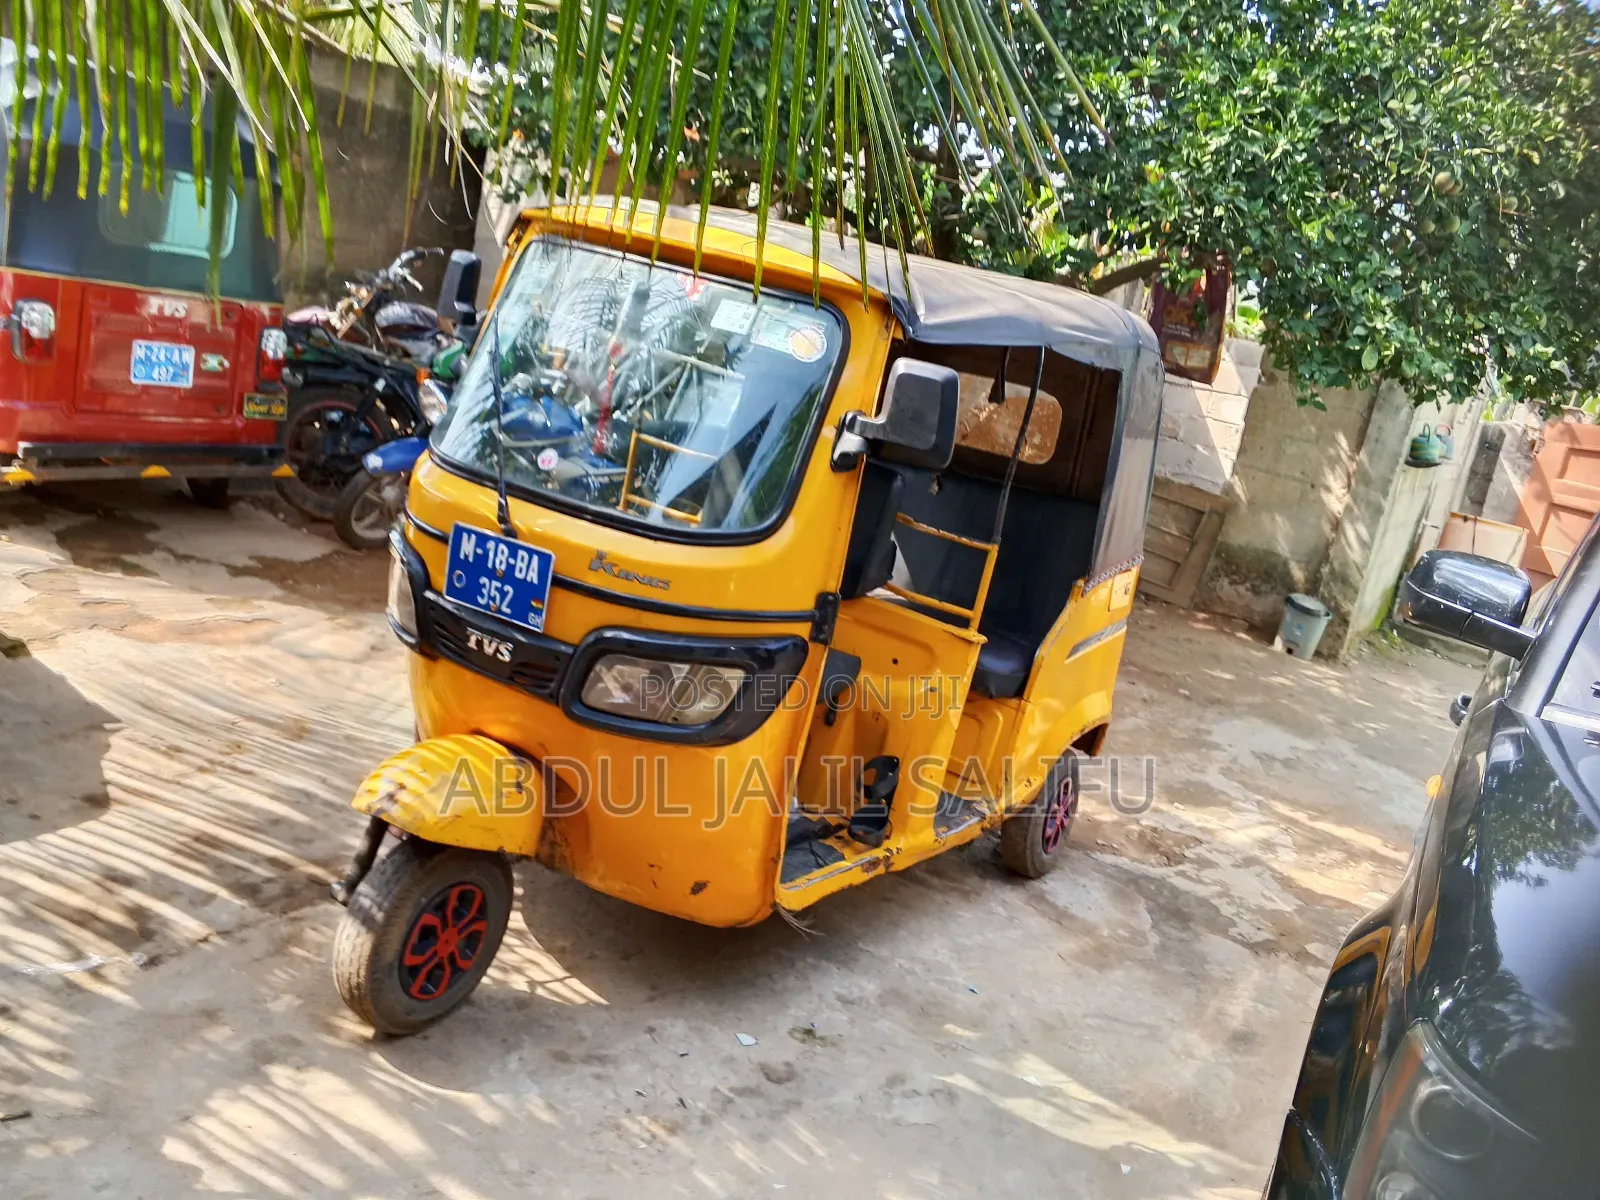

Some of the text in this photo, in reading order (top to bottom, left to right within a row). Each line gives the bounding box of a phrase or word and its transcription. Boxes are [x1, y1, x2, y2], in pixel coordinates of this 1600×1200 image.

[148, 297, 188, 318] TVS
[459, 531, 539, 586] M-18-BA
[476, 576, 514, 614] 352
[466, 627, 514, 662] TVS
